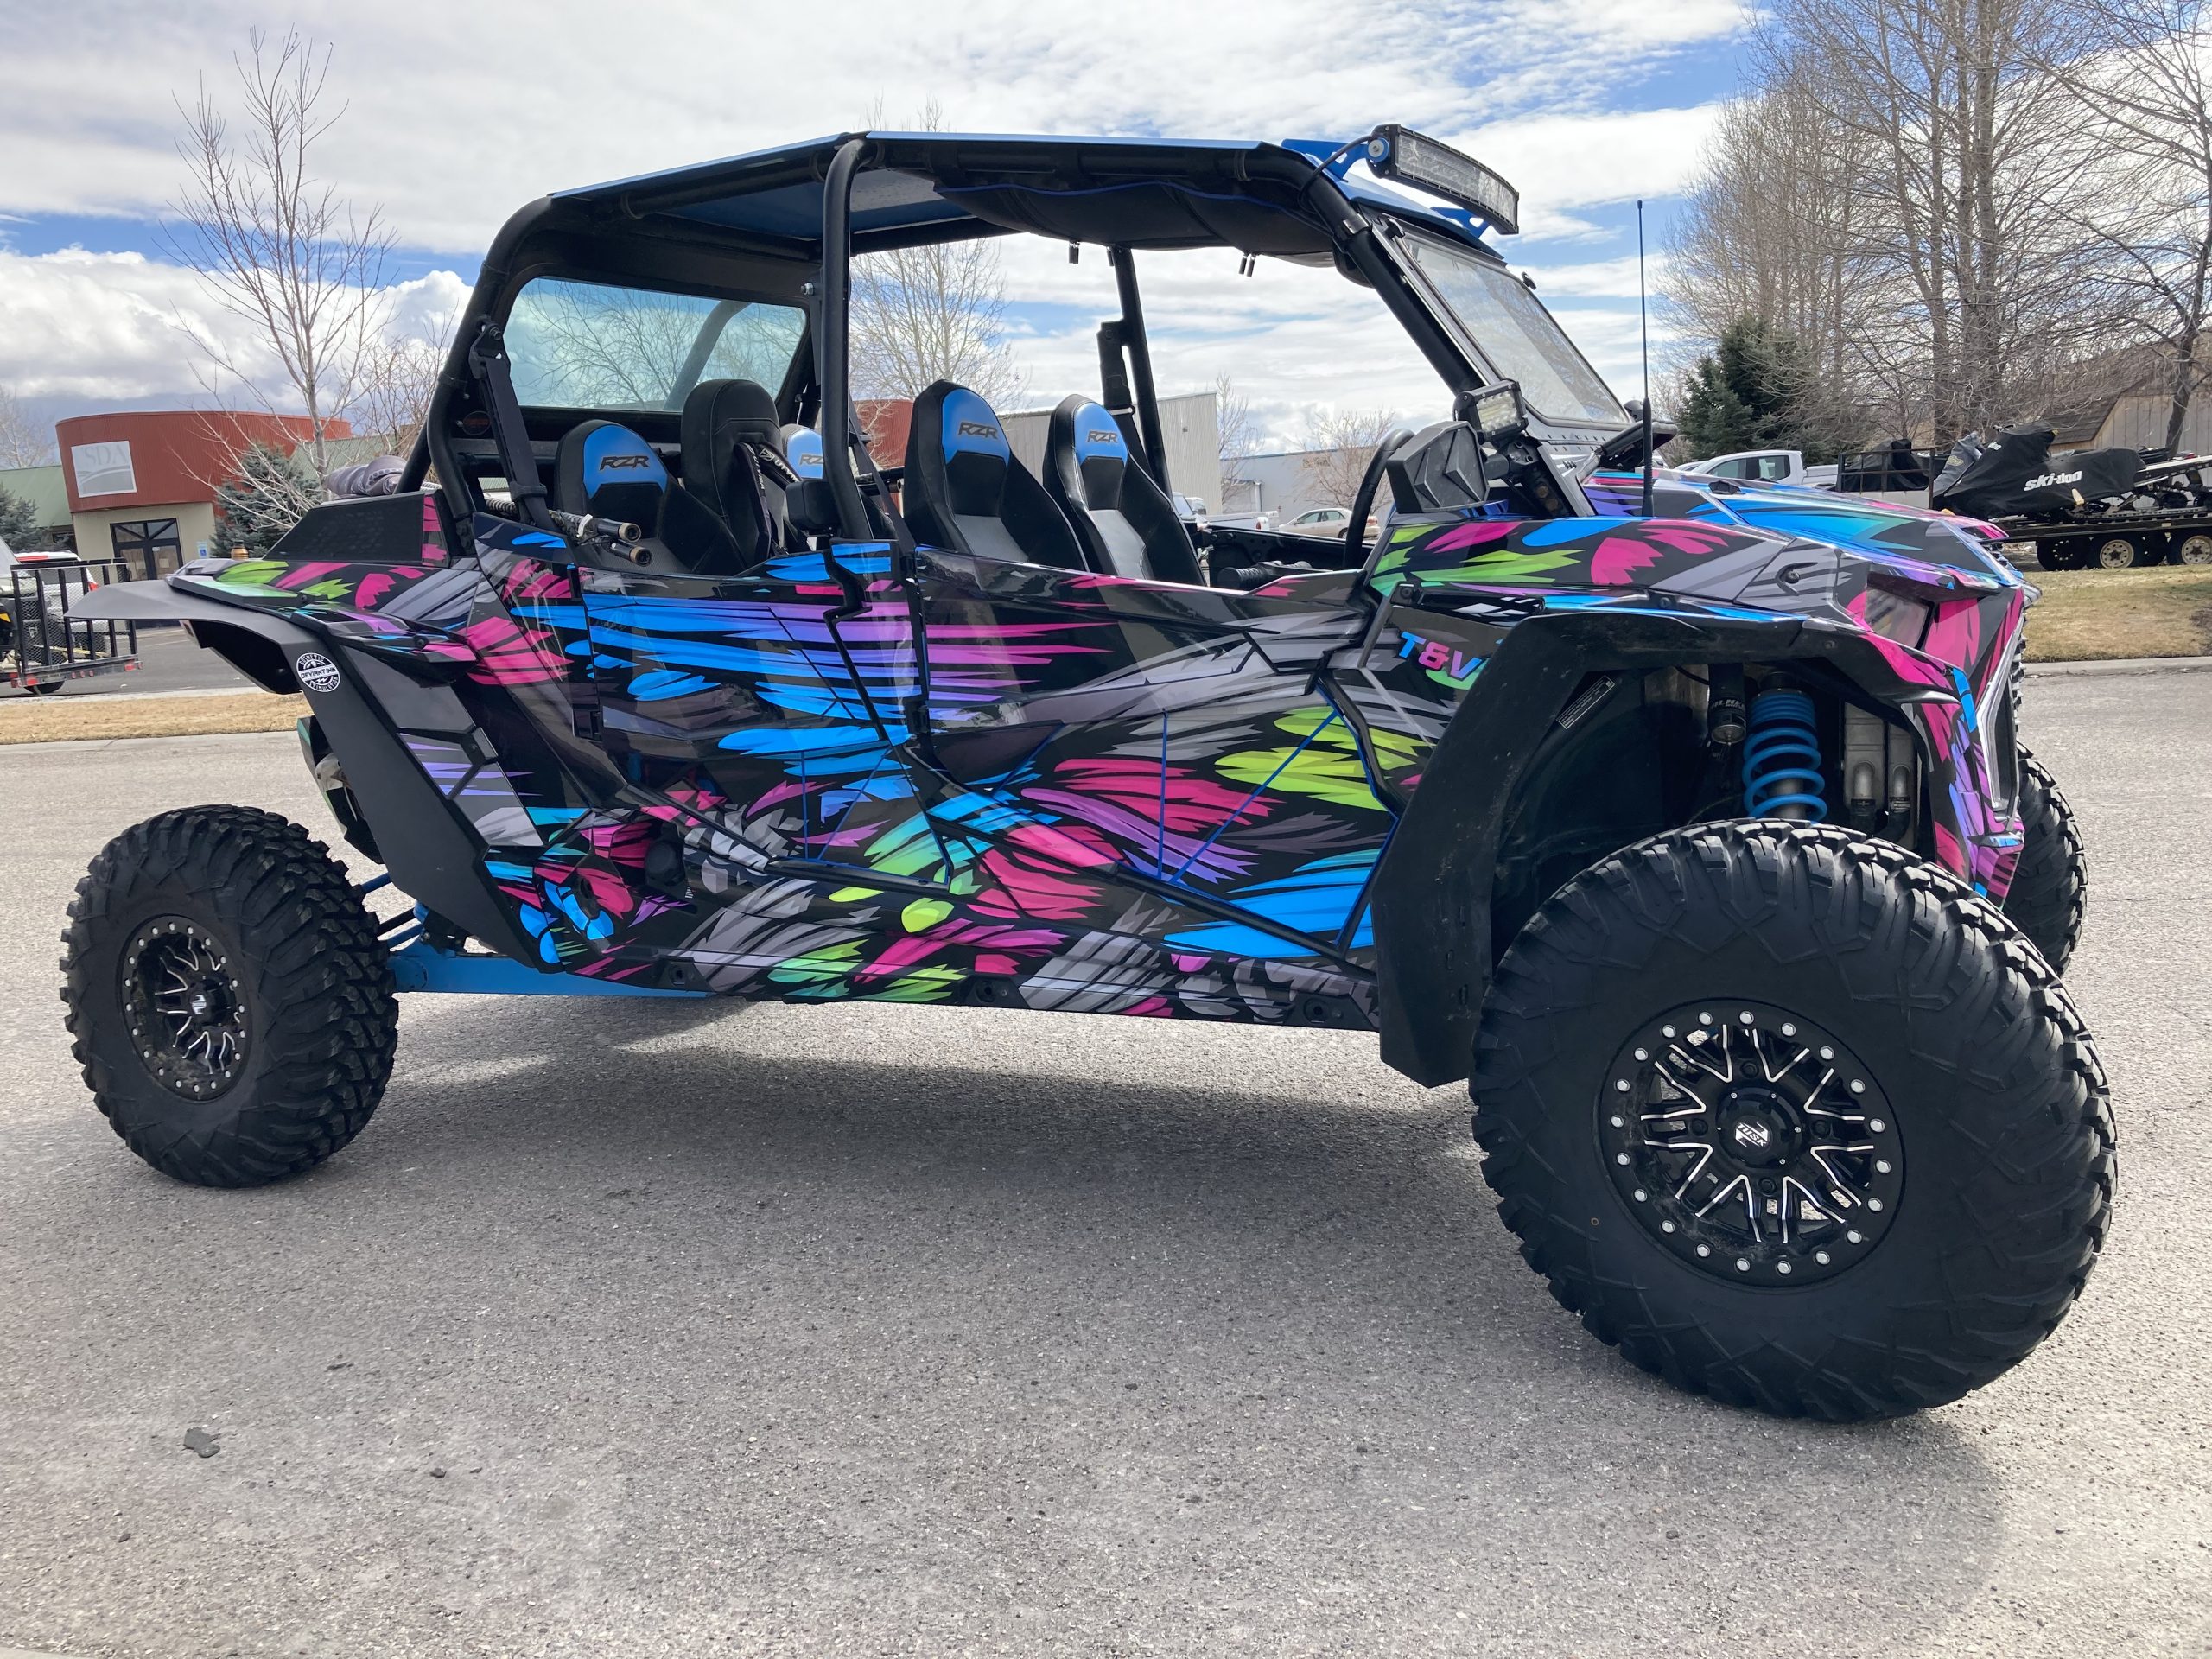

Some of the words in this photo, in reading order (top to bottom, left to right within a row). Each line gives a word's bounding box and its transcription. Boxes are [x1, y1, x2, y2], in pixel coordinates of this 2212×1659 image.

[957, 421, 998, 439] RZR
[1086, 430, 1118, 443] RZR
[599, 455, 650, 471] RZR
[799, 454, 823, 466] RZ
[774, 459, 800, 483] UTVM
[1398, 631, 1484, 681] T&V
[301, 668, 327, 679] DEVIANT
[326, 666, 337, 675] INK
[1737, 1122, 1767, 1147] TUSK
